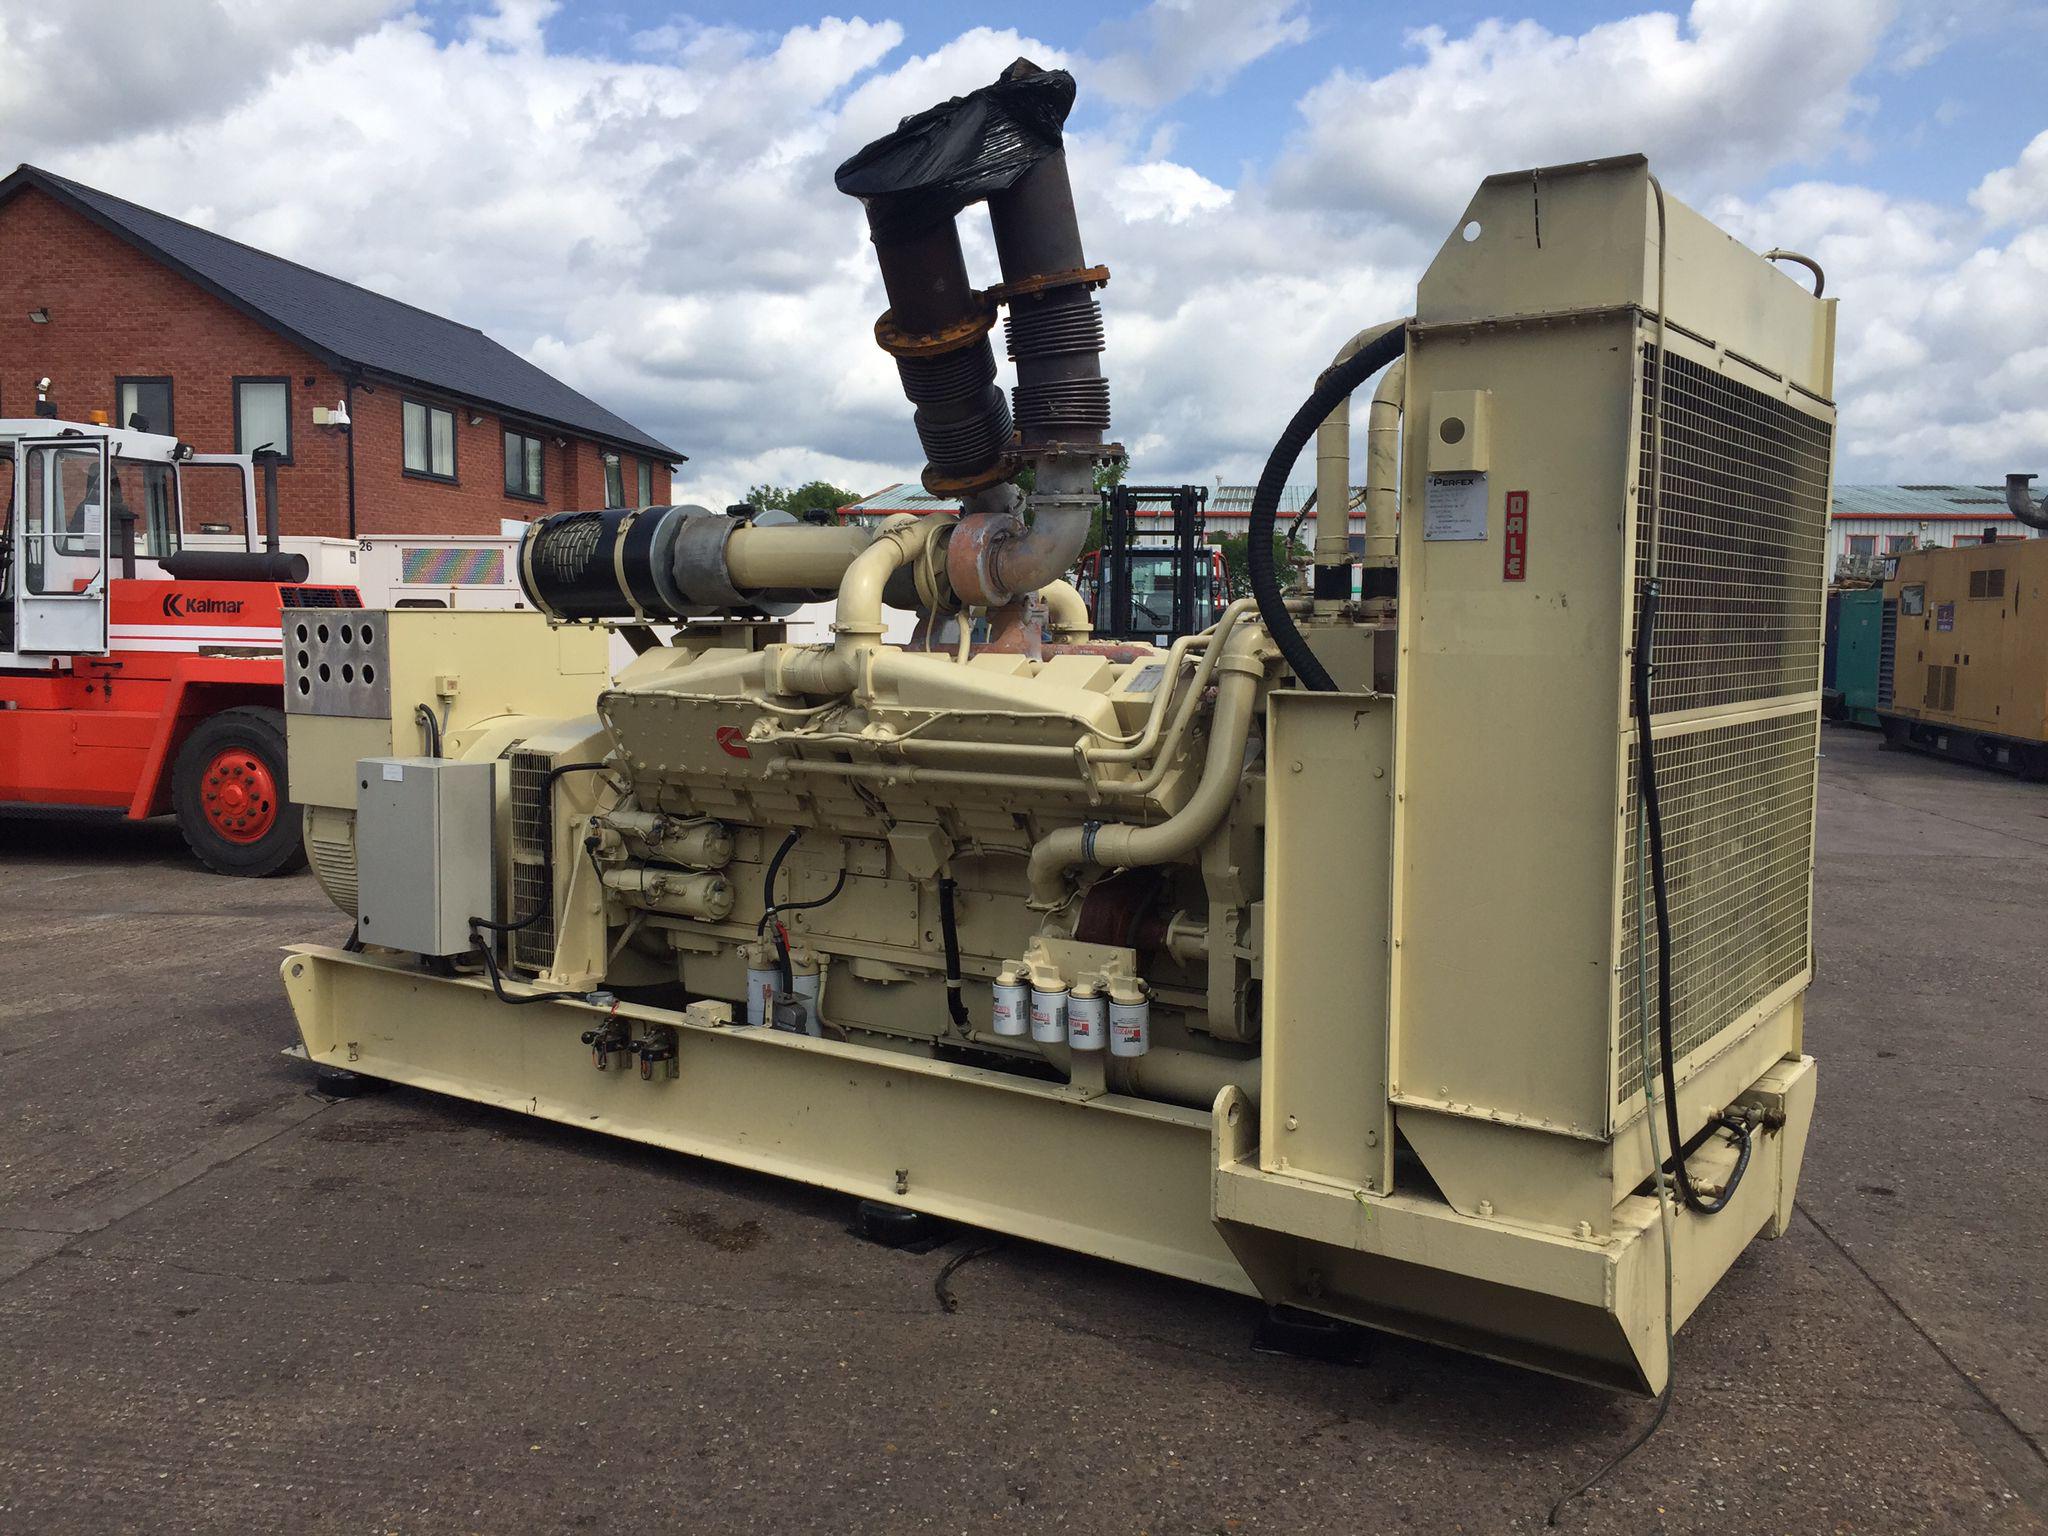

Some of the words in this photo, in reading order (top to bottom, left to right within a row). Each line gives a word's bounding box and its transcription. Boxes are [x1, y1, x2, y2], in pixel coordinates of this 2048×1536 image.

[1433, 478, 1474, 487] PERFEX
[1506, 496, 1525, 576] DALE
[359, 541, 373, 552] 26
[186, 598, 244, 613] Kalmar
